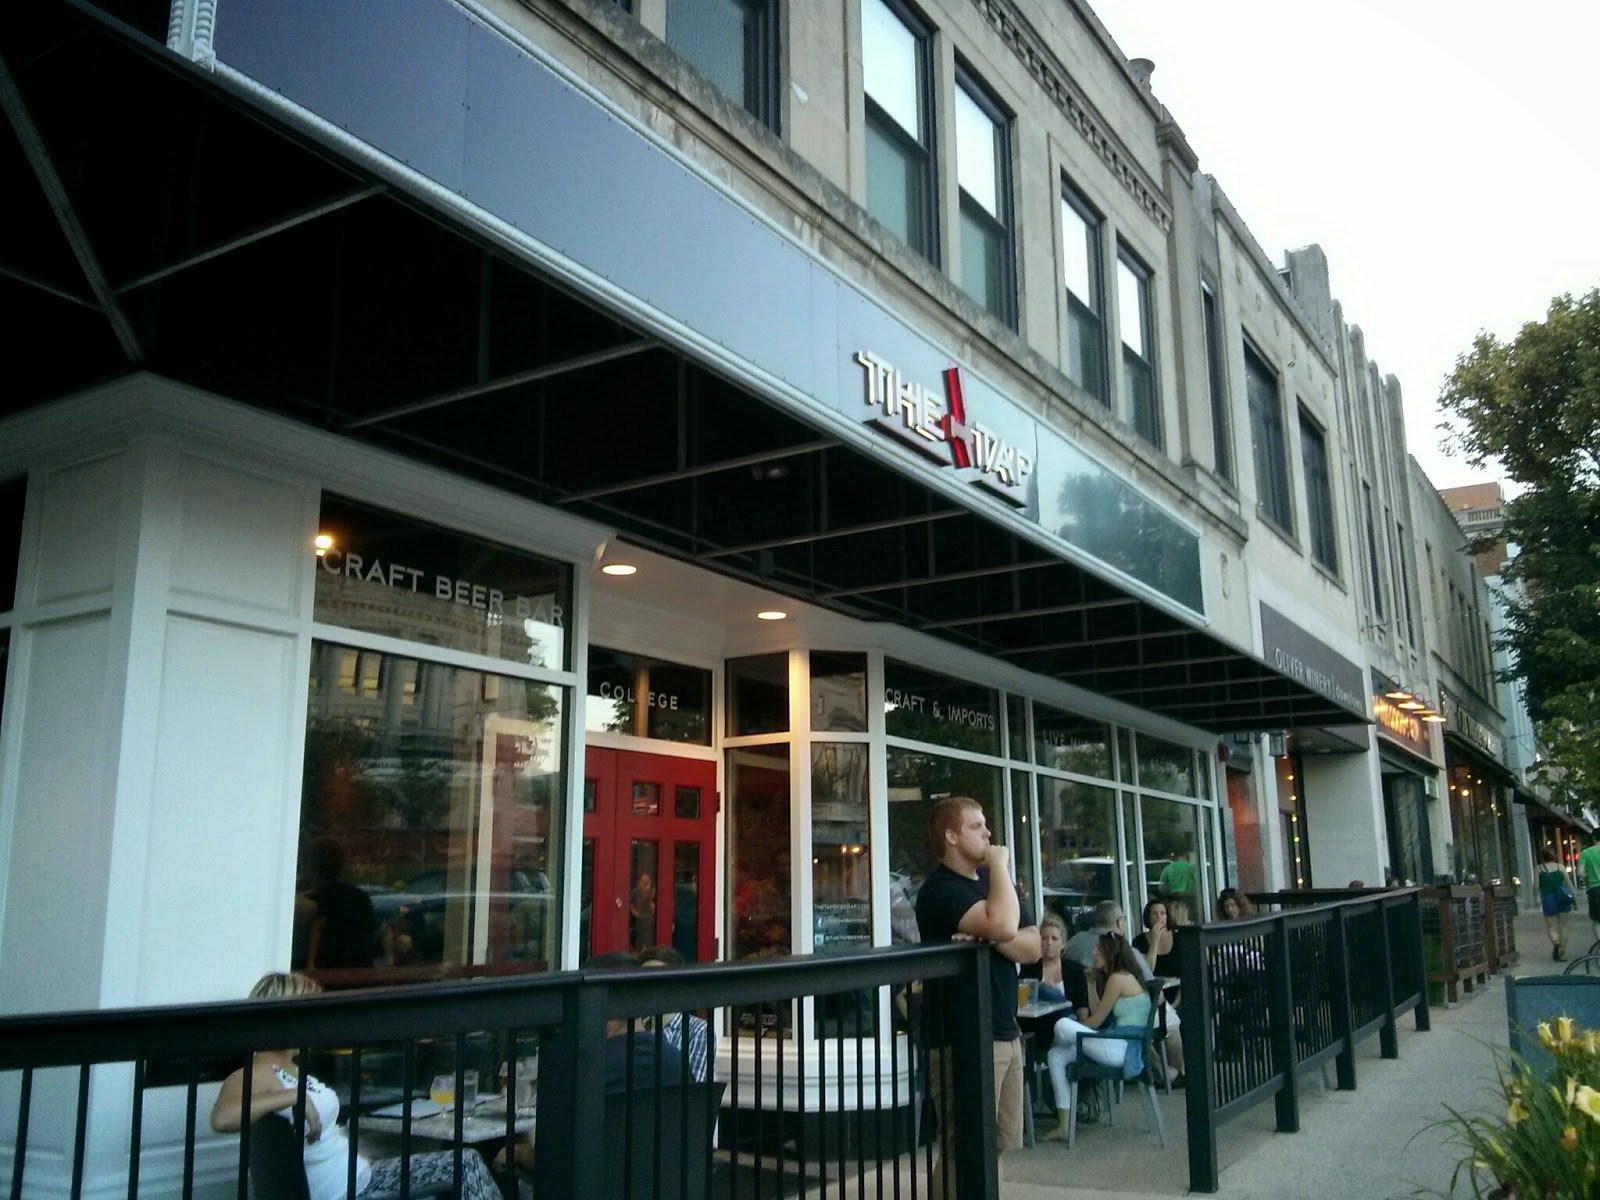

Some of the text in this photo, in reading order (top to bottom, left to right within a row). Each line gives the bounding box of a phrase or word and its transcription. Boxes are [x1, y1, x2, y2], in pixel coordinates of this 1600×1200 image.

[855, 350, 946, 441] THE
[956, 417, 1033, 487] TAP
[321, 549, 563, 627] CRAFT BEER BAR
[600, 681, 678, 710] COLEGE
[885, 688, 995, 731] CRAFT & IMPORTS
[1042, 729, 1065, 747] LIVE
